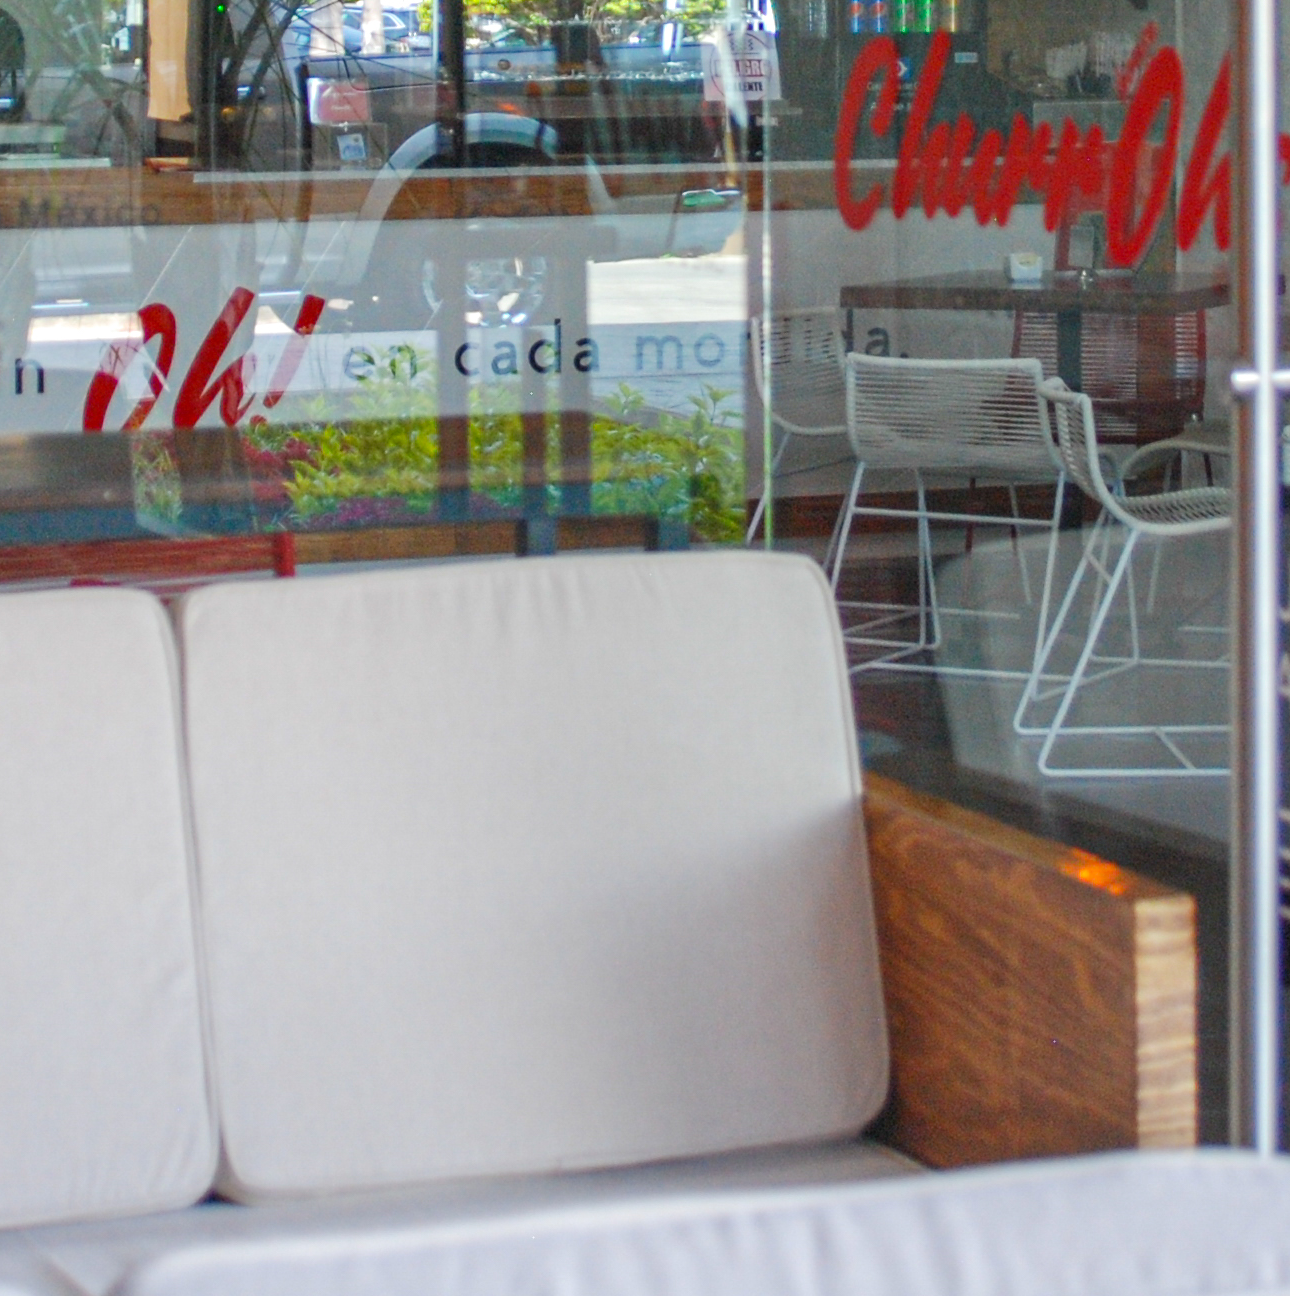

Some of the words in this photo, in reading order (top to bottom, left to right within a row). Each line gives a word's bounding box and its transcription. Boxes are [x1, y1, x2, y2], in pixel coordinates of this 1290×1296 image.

[82, 287, 326, 431] Oh!
[343, 343, 418, 384] en
[454, 318, 601, 376] cada
